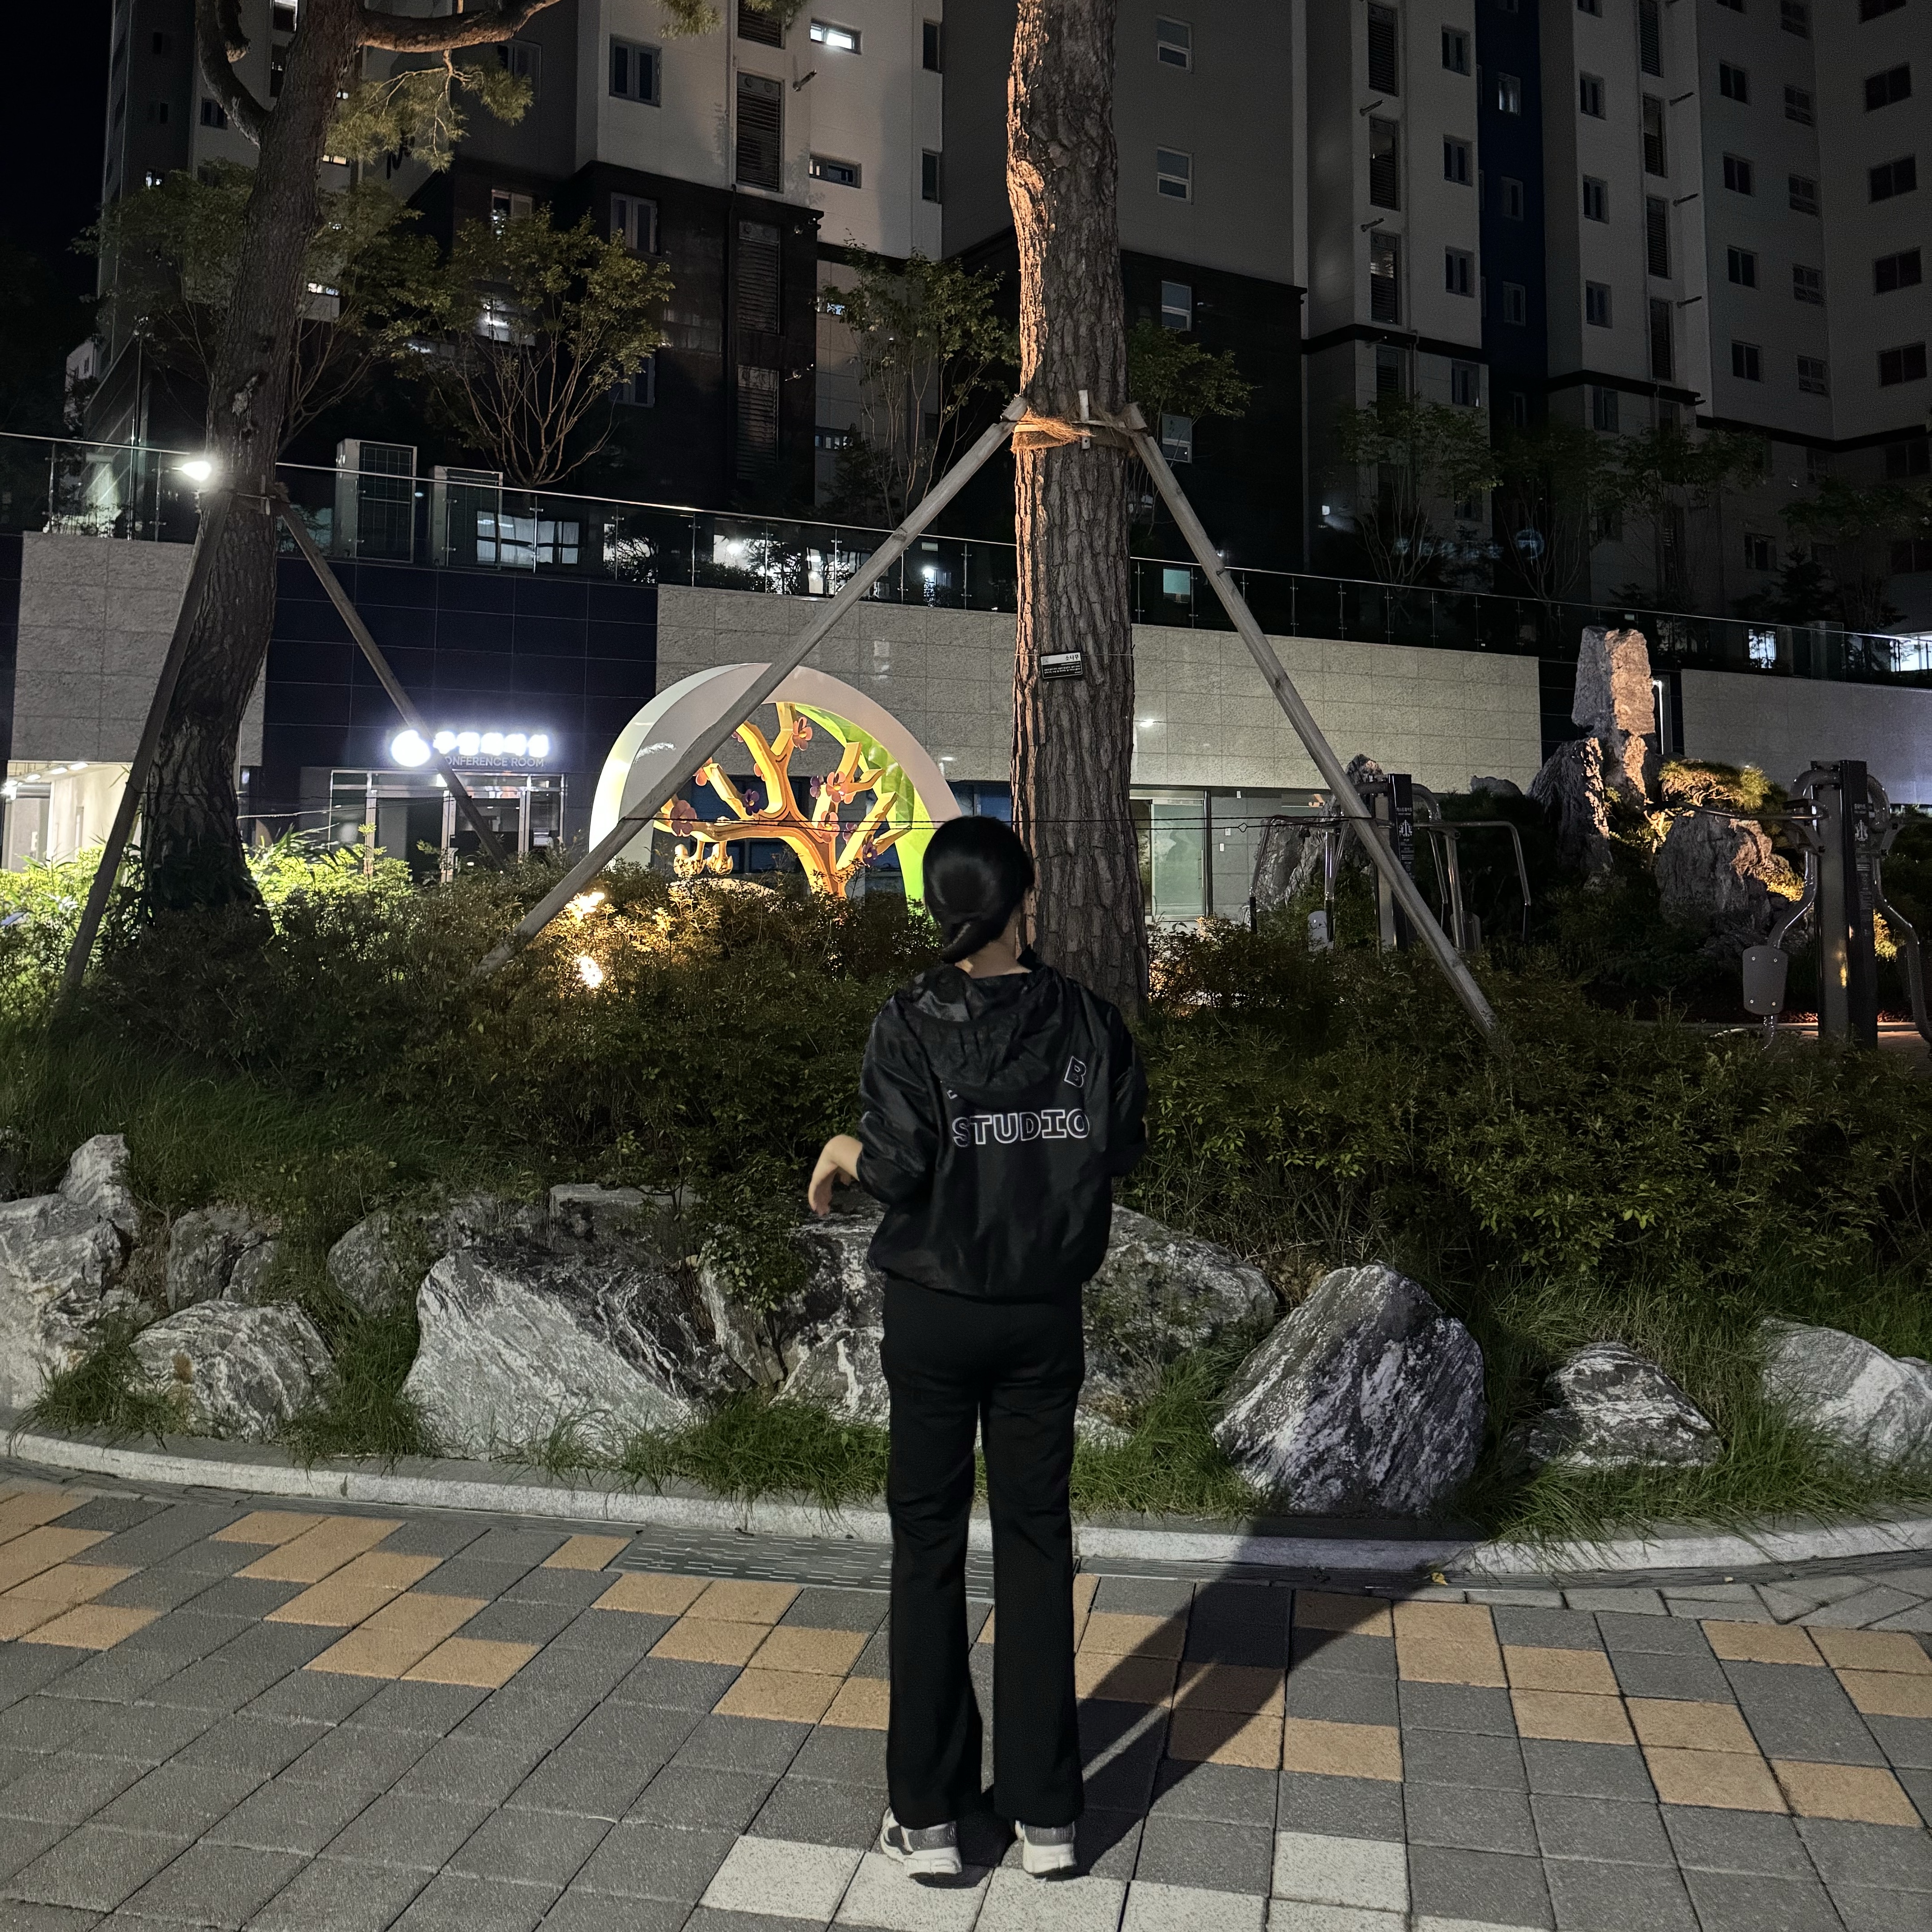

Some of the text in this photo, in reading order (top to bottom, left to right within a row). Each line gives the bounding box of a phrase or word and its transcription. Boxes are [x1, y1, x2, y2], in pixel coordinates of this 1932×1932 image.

[445, 755, 544, 767] ONFERENCE ROOM
[951, 1108, 1090, 1147] STUDIO
